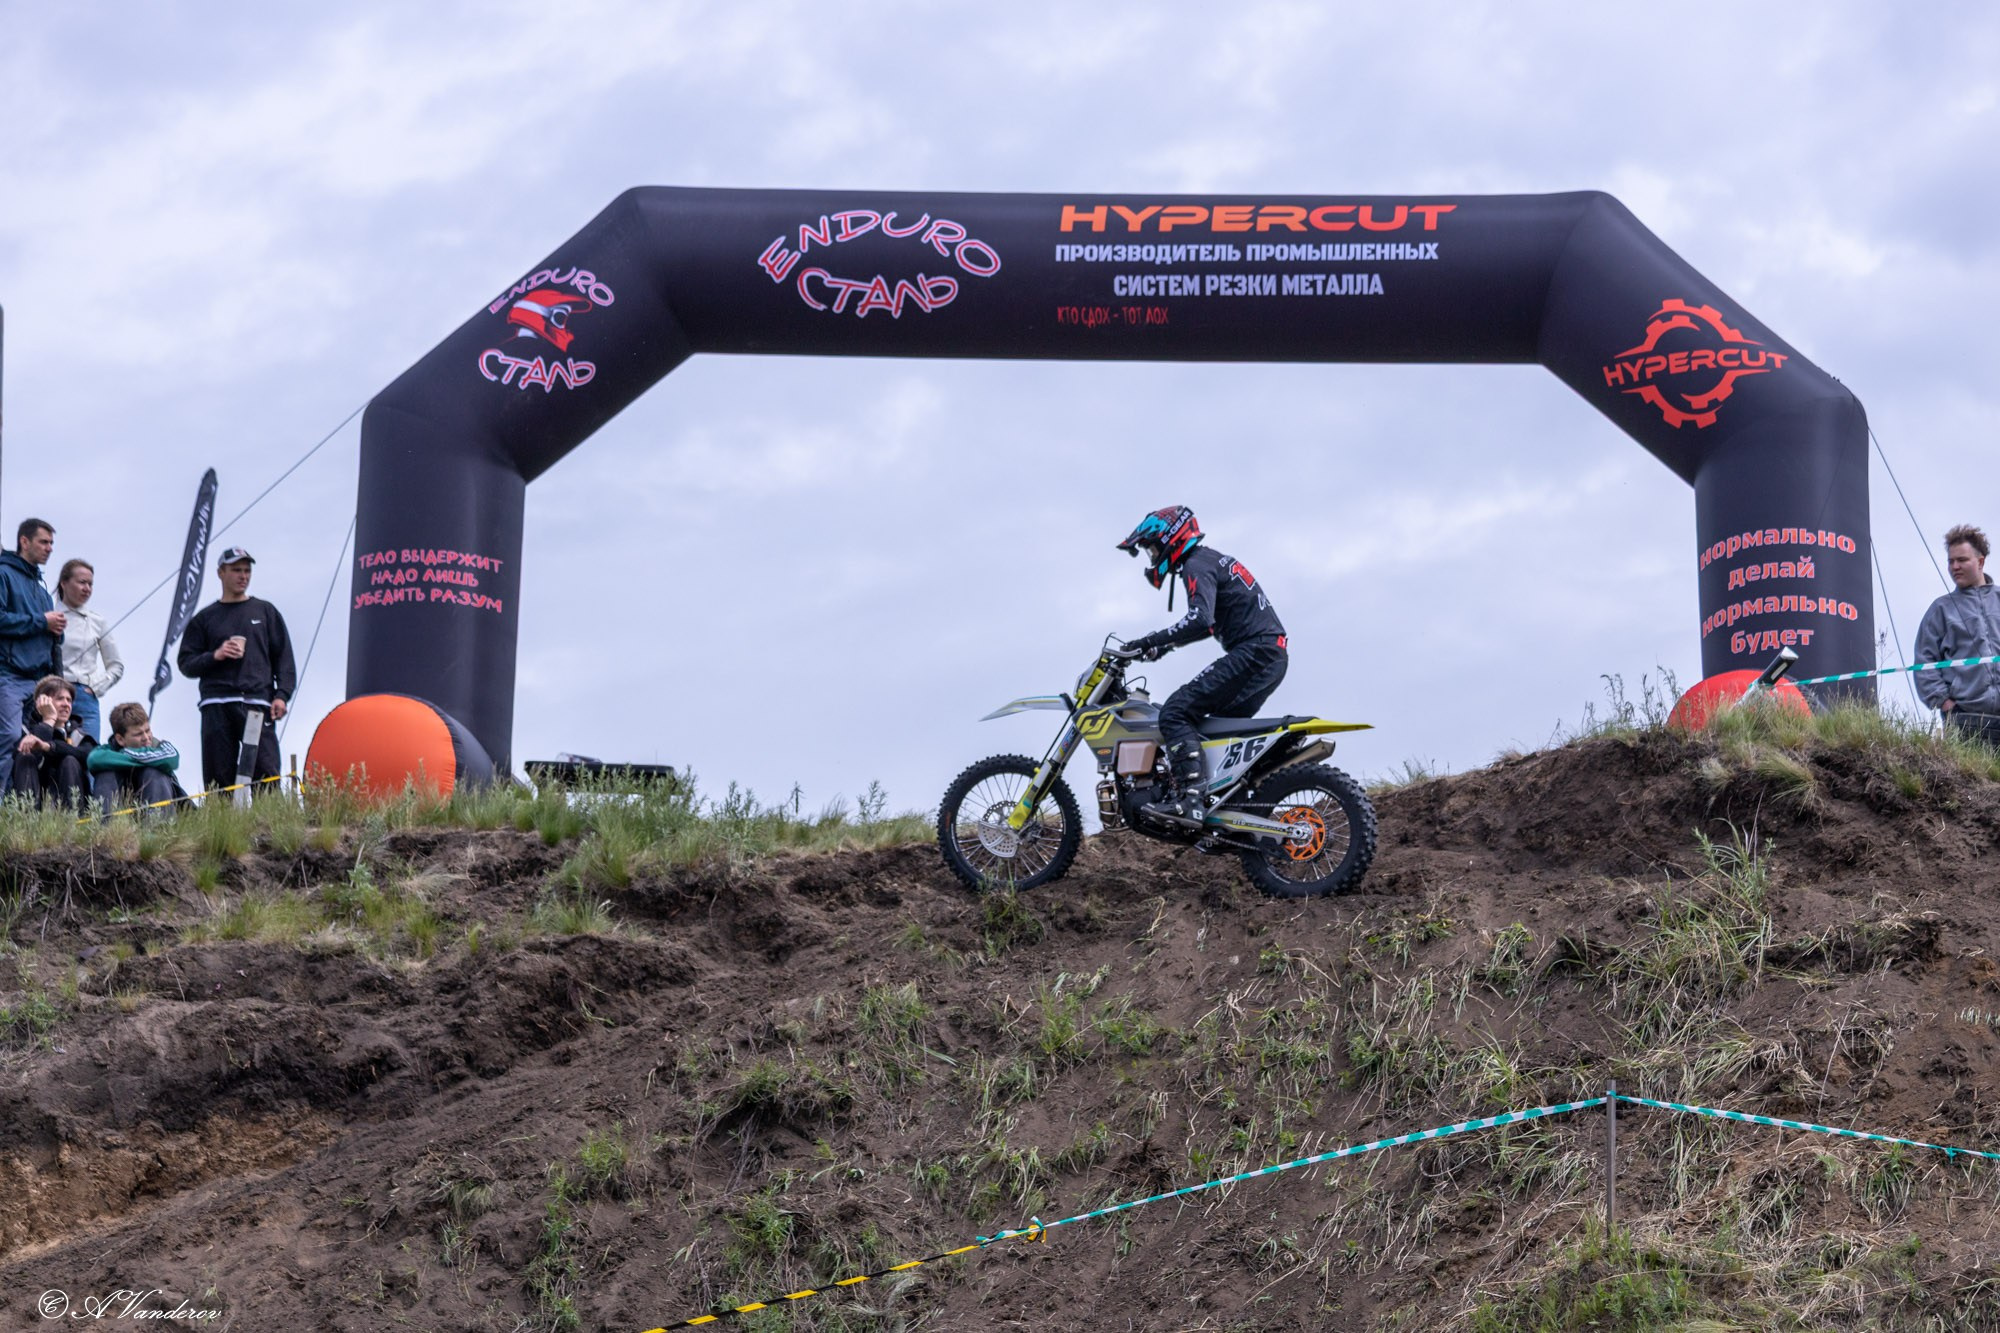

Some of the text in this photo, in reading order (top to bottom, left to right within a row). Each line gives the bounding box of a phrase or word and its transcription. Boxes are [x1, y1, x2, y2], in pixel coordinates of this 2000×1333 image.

[1060, 205, 1457, 232] HYPERCUT
[757, 210, 1001, 283] ENDURO
[1055, 243, 1439, 265] ПРОИЗВОДИТЕЛЬ ПРОМЫШЛЕННЫХ
[488, 267, 615, 315] ENDURO
[1113, 273, 1384, 296] СИСТЕМ РЕЗКИ МЕТАЛЛА
[1057, 306, 1078, 325] КТО
[1081, 306, 1110, 328] СДОХ
[1122, 306, 1142, 325] ТОТ
[1145, 306, 1169, 325] ЛОХ
[1603, 348, 1789, 387] HYPERCUT
[358, 549, 503, 573] ТЕЛО ВЫДЕРЖИТ
[1700, 527, 1856, 571] нормально
[371, 568, 479, 587] НАДО ЛИШЬ
[1728, 555, 1815, 591] делай
[354, 587, 503, 613] УБЕДИТЬ РАЗУМ
[1702, 595, 1858, 639] нормально
[1731, 629, 1814, 655] будет
